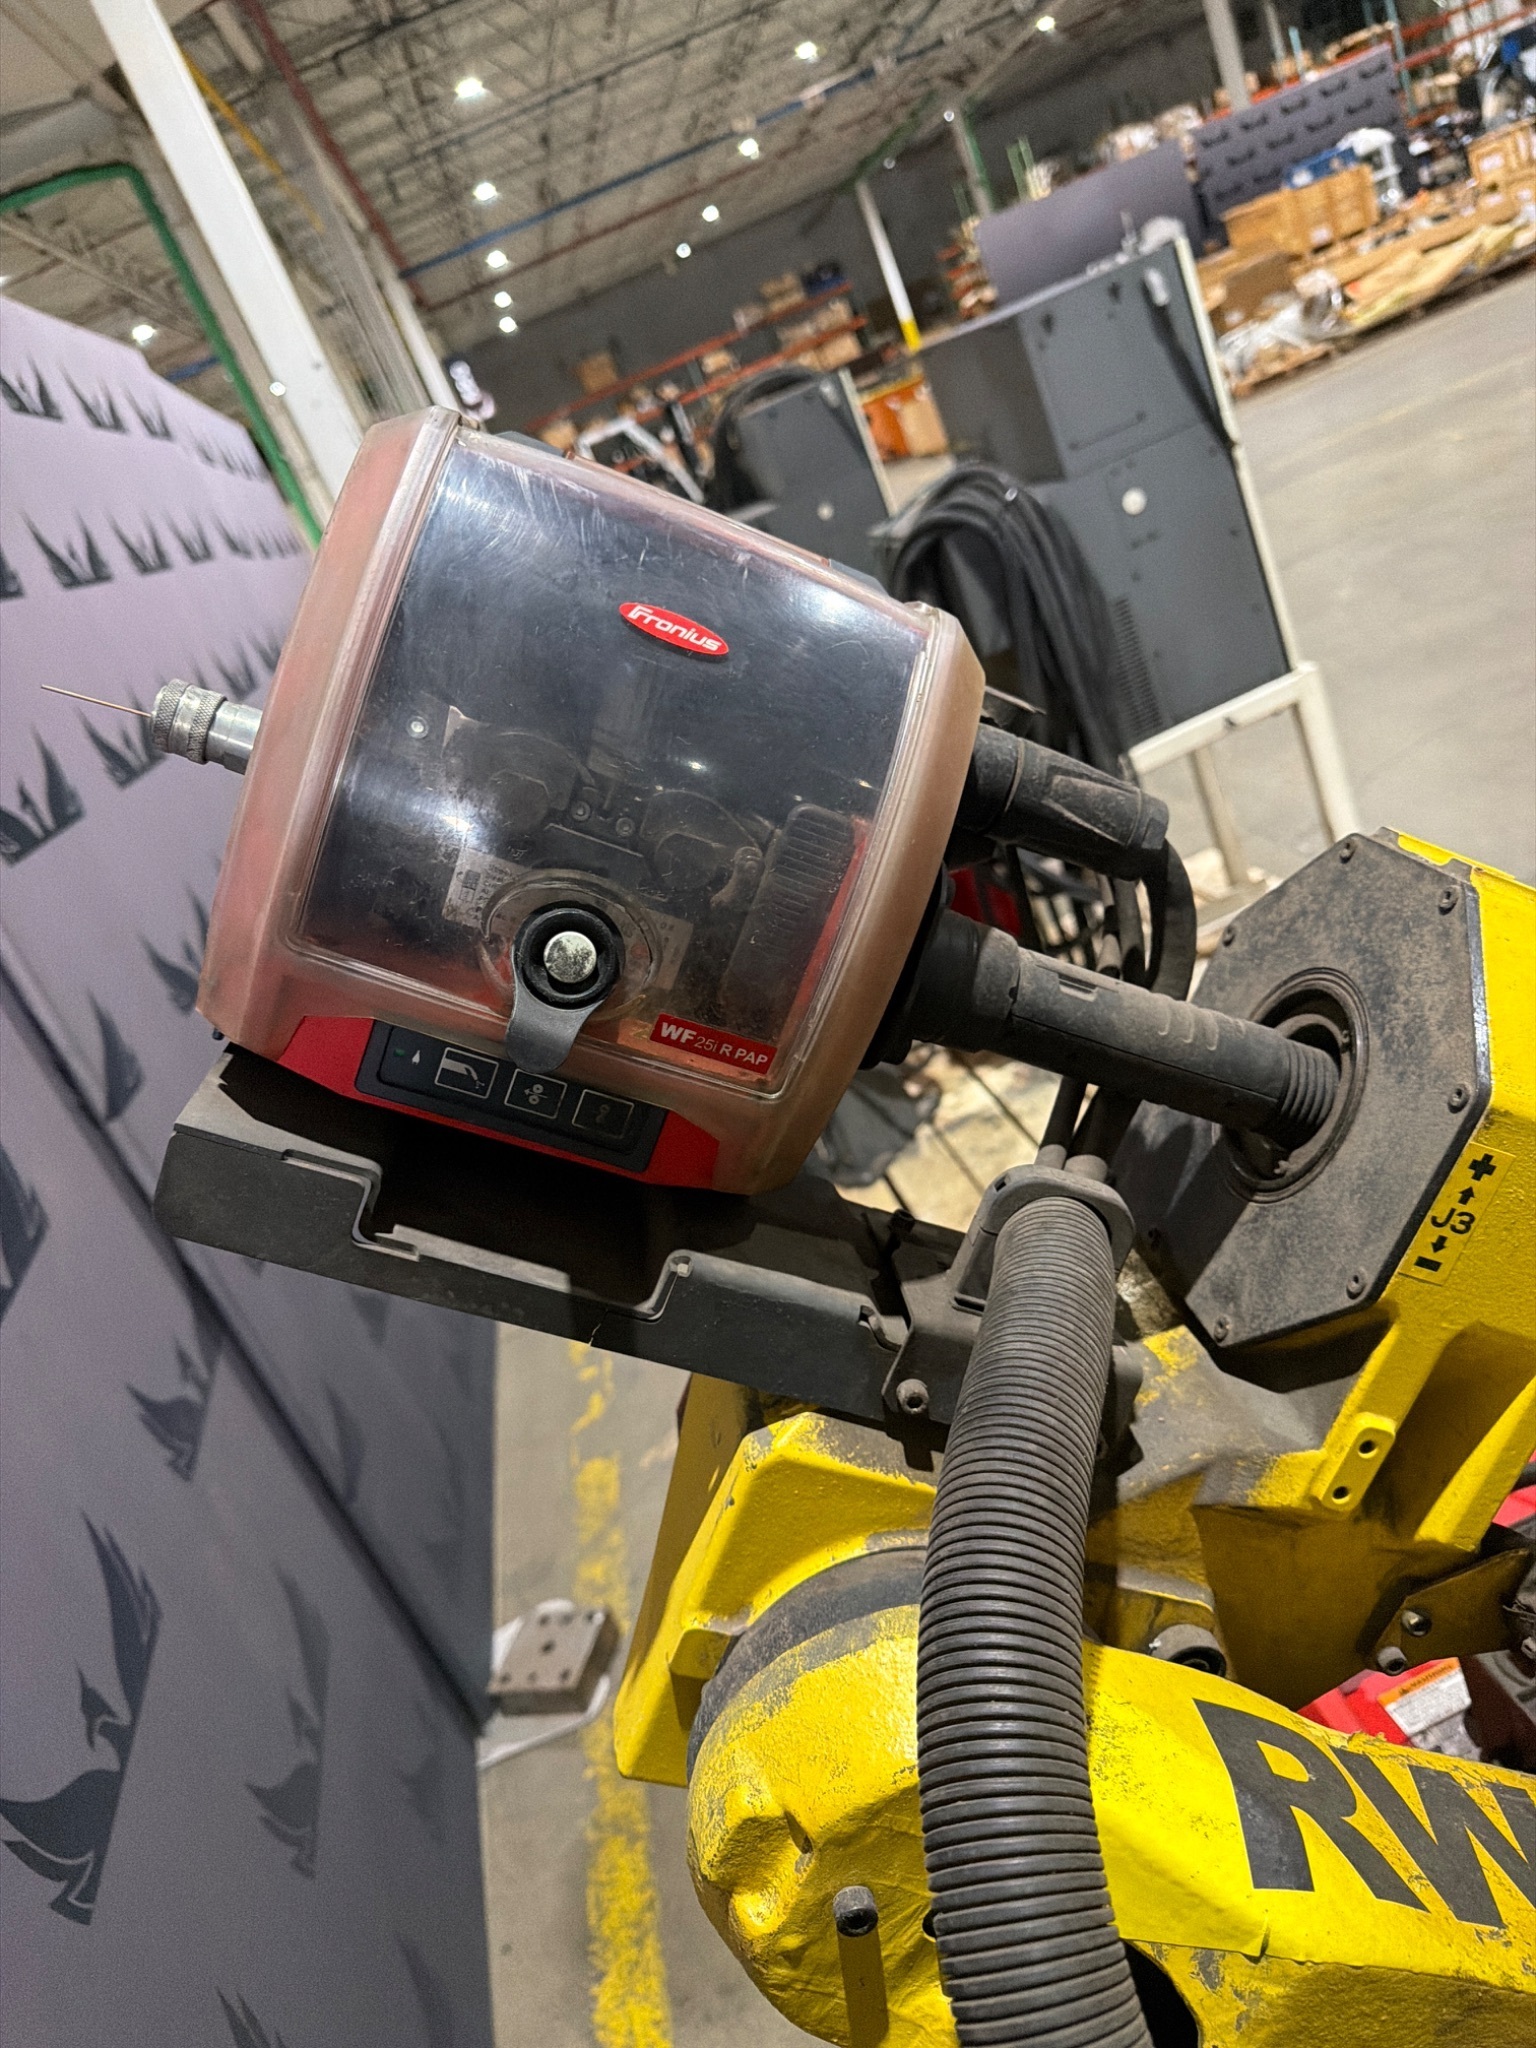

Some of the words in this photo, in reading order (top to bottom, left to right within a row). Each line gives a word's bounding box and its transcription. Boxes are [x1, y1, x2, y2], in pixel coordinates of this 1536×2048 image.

[627, 604, 722, 651] Fronius
[660, 1021, 697, 1044] WF
[694, 1036, 719, 1053] 25i
[719, 1043, 734, 1057] R
[734, 1047, 769, 1066] PAP
[1430, 1207, 1476, 1235] J3
